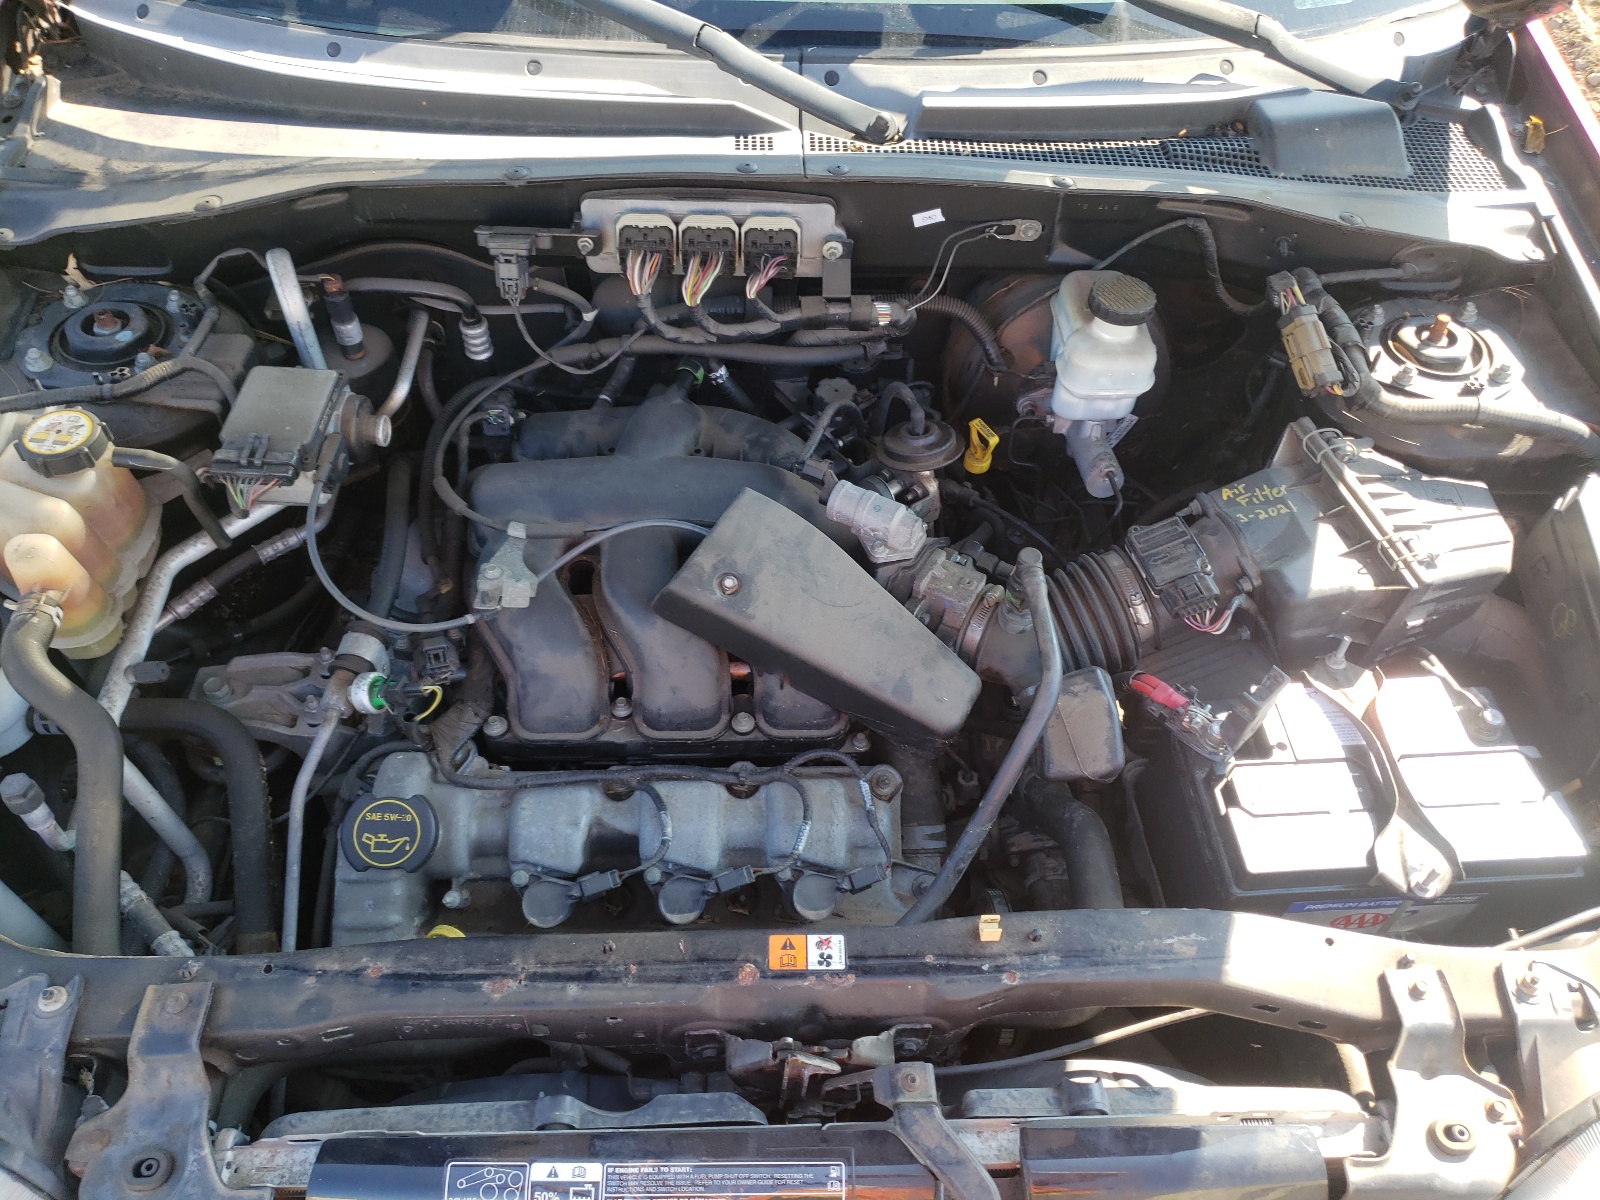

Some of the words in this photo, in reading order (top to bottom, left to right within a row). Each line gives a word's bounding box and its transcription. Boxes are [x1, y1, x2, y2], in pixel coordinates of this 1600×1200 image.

[1221, 483, 1246, 501] Air
[1236, 484, 1288, 507] Filter
[365, 812, 383, 821] SAE
[383, 813, 412, 822] 5W-20
[1303, 902, 1359, 911] PREMIUM
[1358, 900, 1403, 908] BATTER
[1332, 913, 1386, 929] AAA
